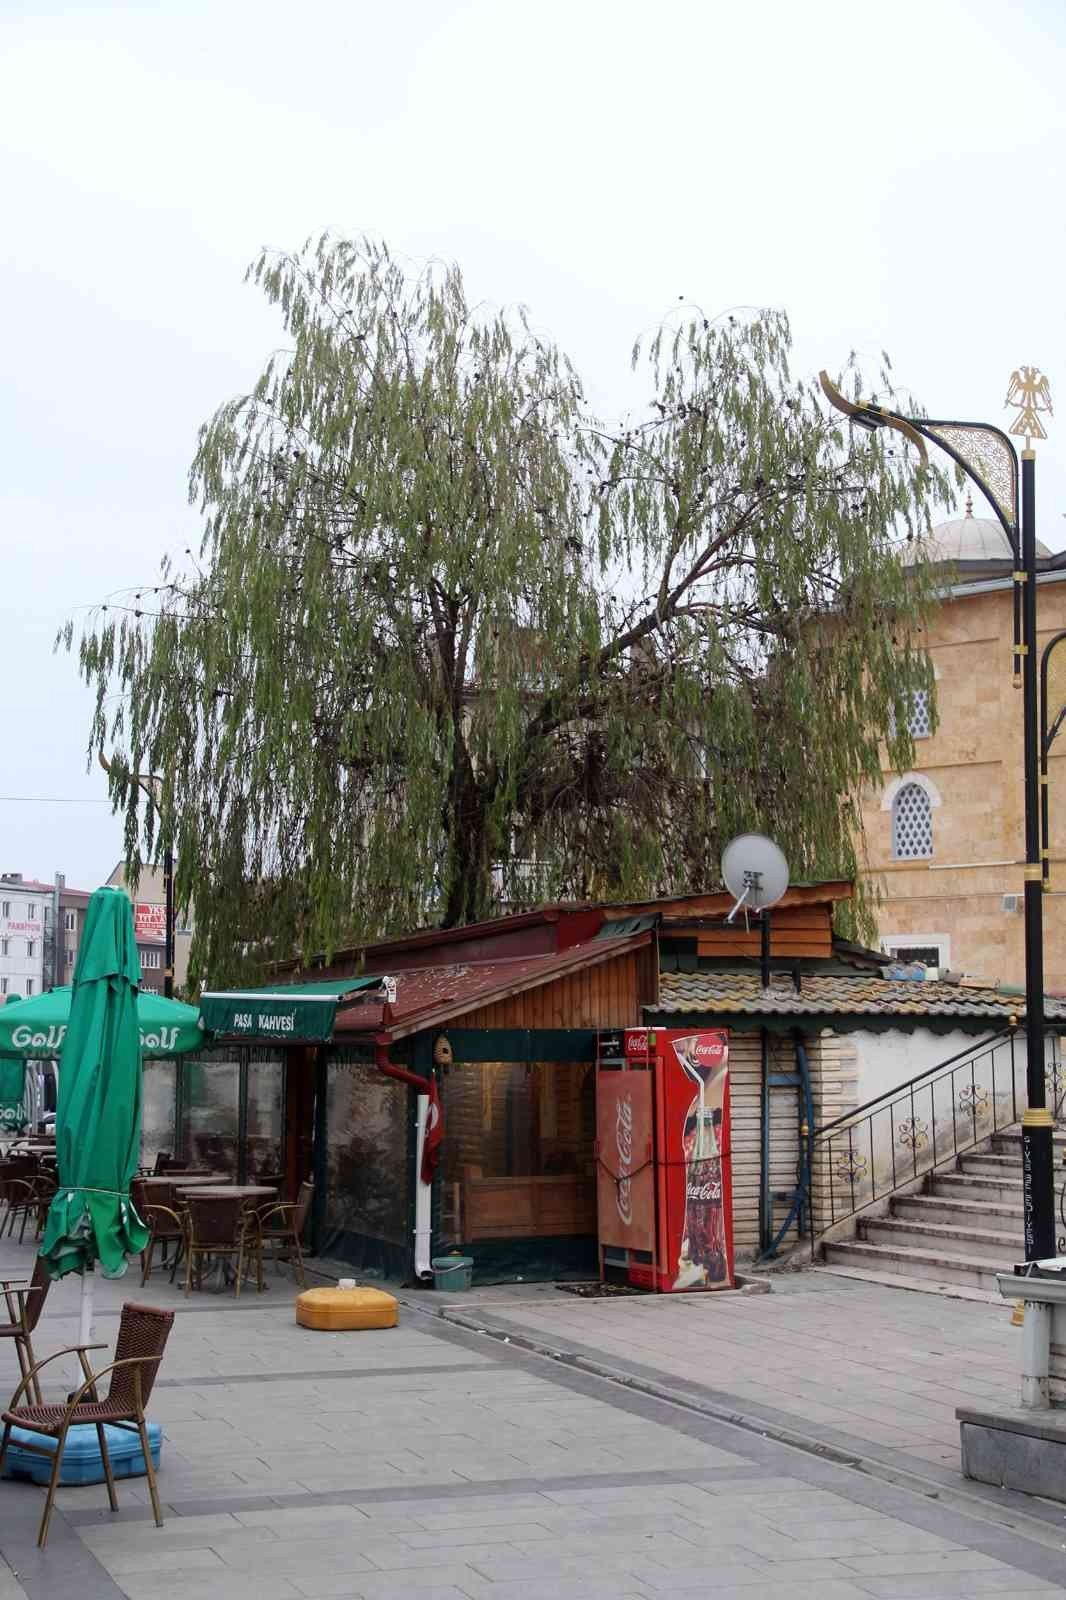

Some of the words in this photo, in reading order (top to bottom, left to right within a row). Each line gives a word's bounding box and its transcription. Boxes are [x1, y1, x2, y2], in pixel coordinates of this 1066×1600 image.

[233, 1013, 253, 1031] PAŞA
[258, 1012, 295, 1031] KAHVESİ
[11, 1025, 67, 1049] Golf
